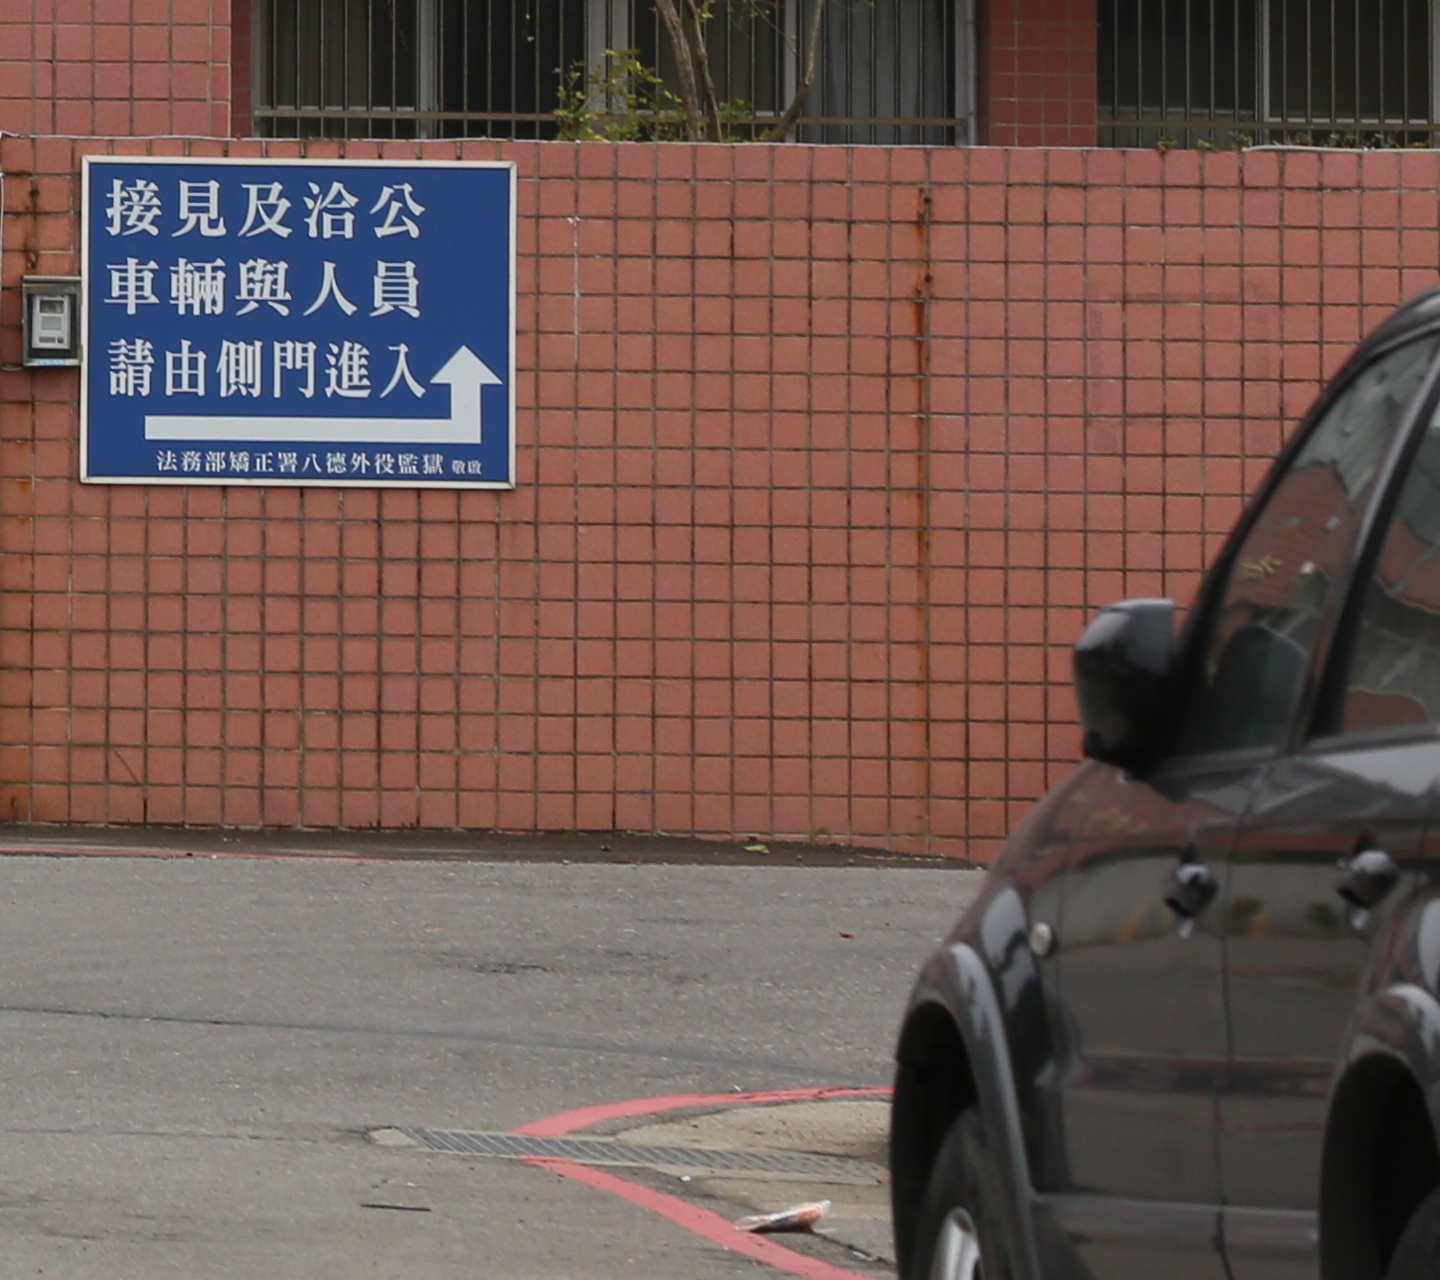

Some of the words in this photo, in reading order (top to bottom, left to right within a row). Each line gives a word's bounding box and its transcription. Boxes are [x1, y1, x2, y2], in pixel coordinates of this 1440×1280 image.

[104, 178, 426, 240] 接見及洽公
[103, 256, 421, 318] 車輛與人員
[107, 337, 427, 399] 請由側門進入
[155, 449, 444, 475] 法務部矯正署八德外役監獄
